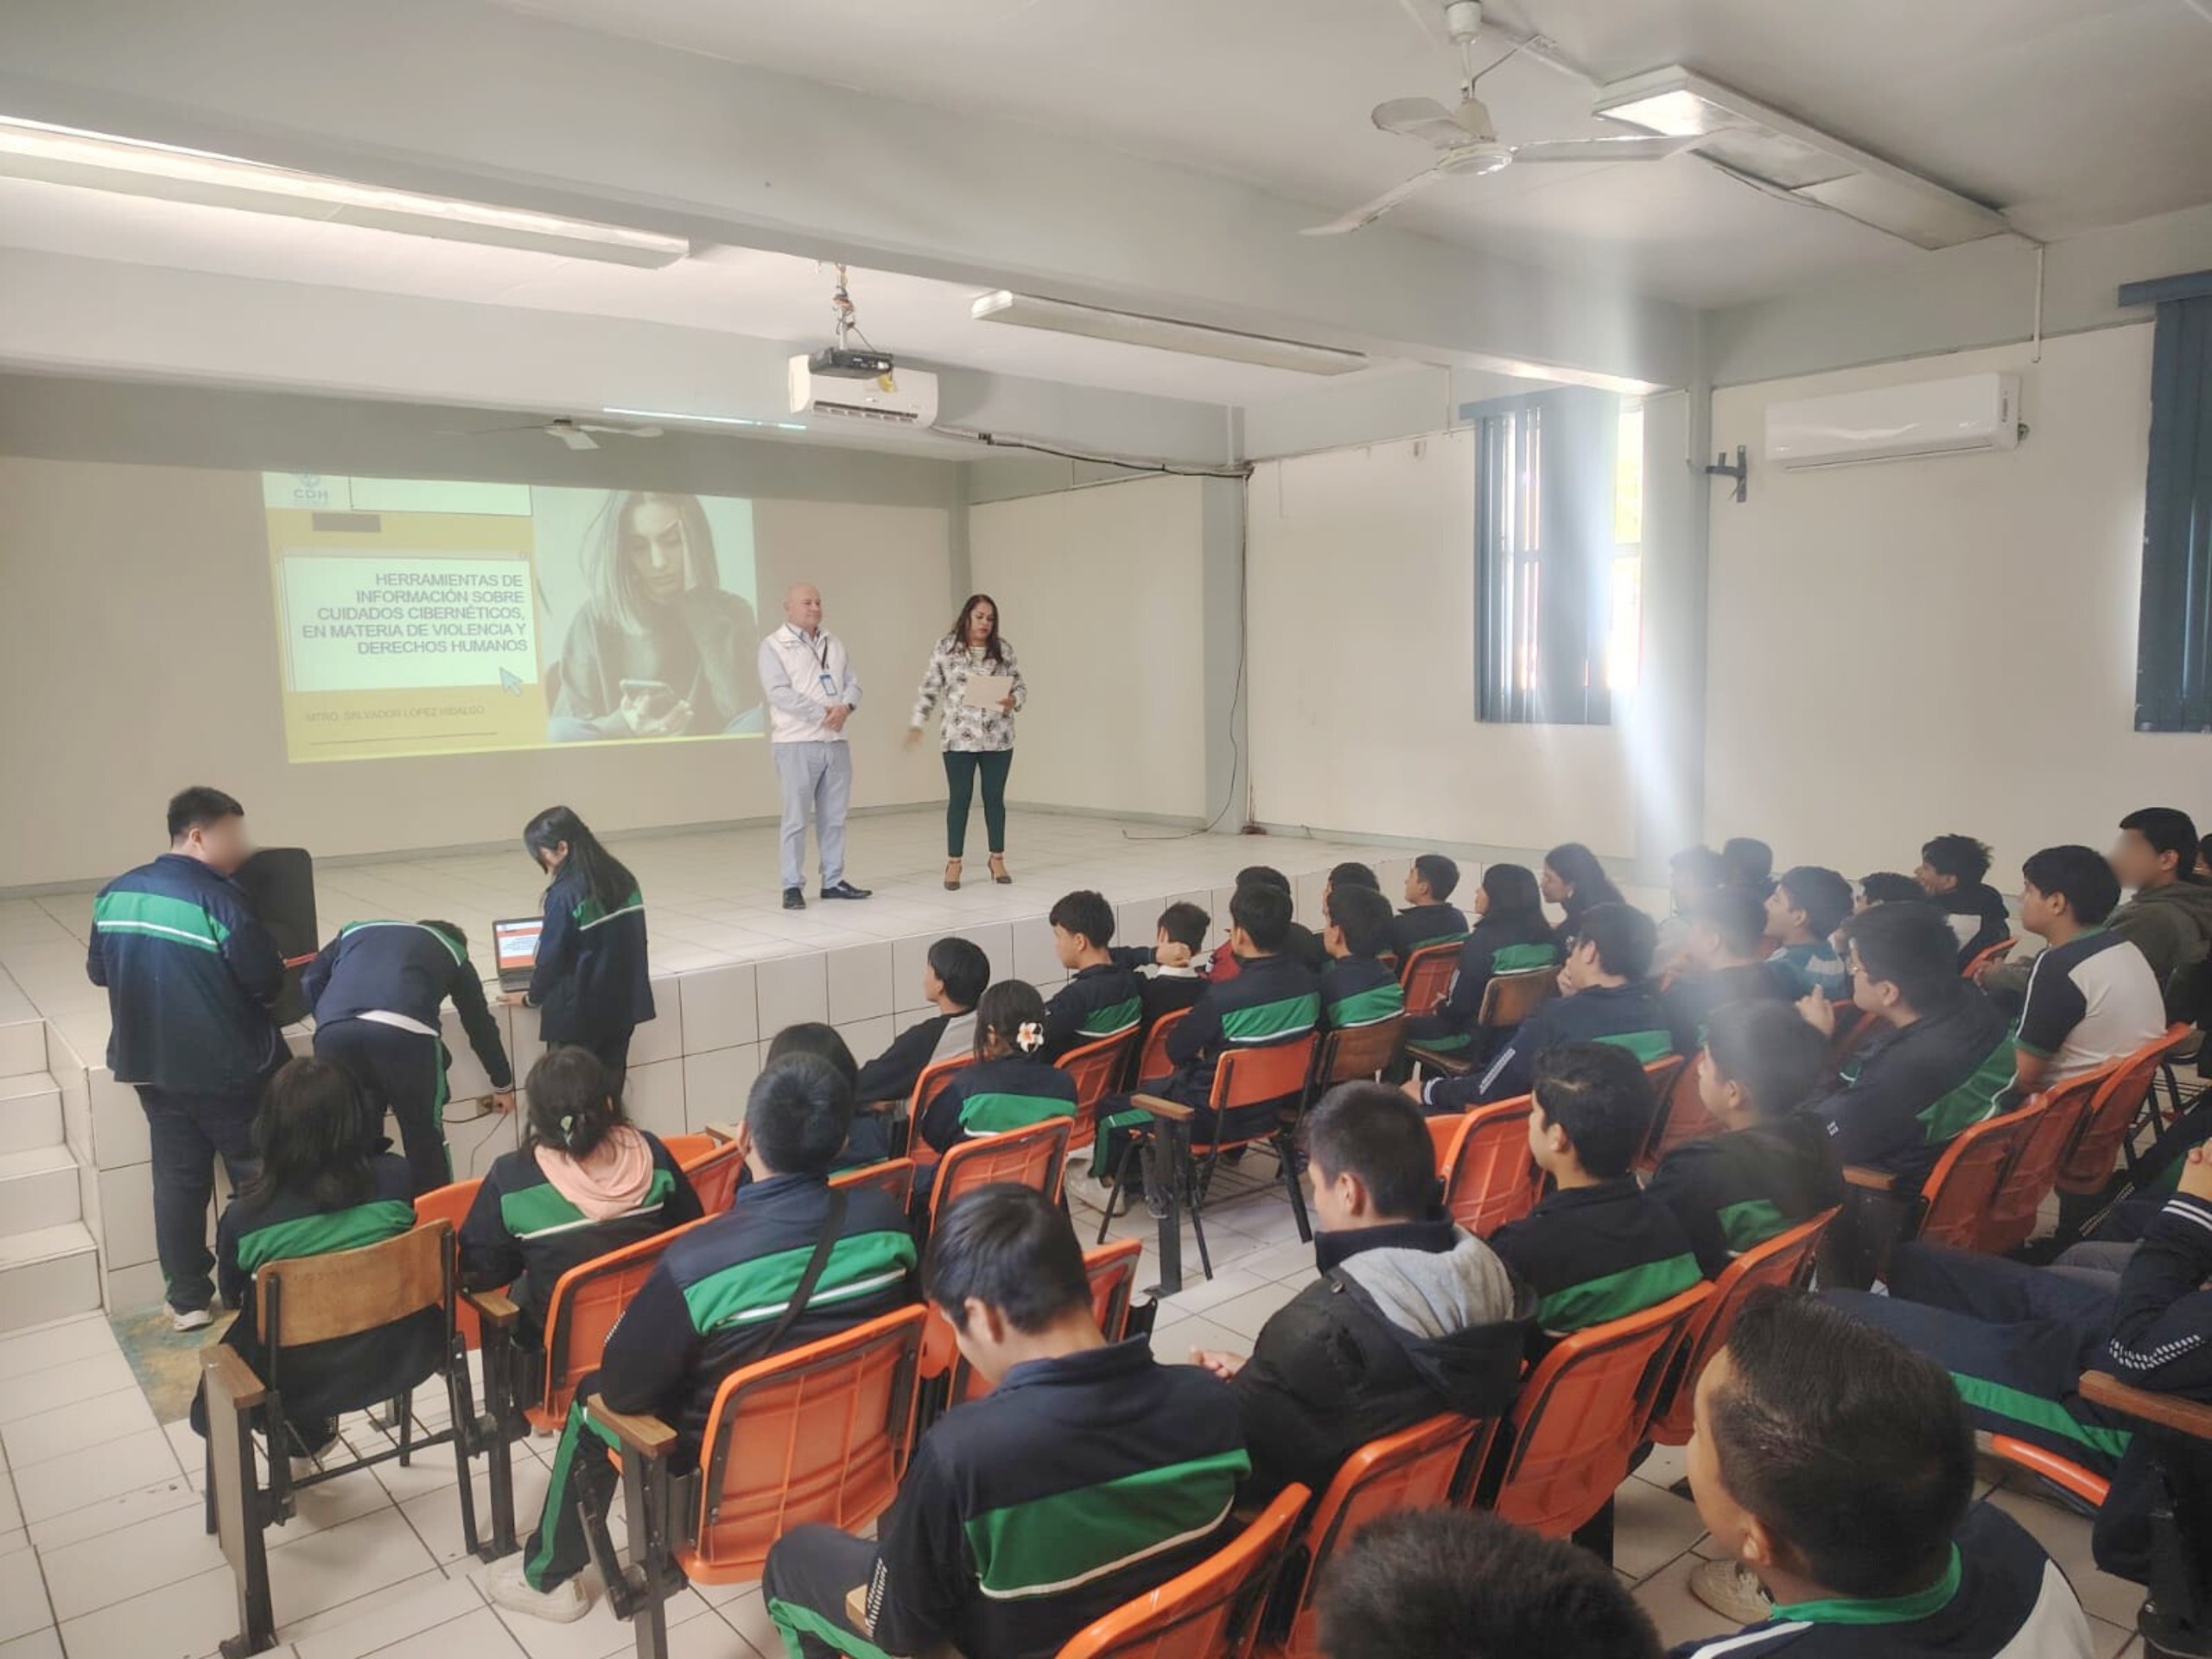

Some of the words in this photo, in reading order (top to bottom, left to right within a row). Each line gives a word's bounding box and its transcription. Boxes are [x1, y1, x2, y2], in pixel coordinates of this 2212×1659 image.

[293, 489, 328, 499] CDH
[375, 573, 499, 587] HERRAMIENTAS
[502, 575, 524, 587] DE
[356, 588, 468, 603] INFORMACIÓN
[472, 590, 524, 604] SOBRE
[317, 607, 404, 620] CUIDADOS
[408, 605, 525, 621] CIBERNÉTICOS,
[302, 625, 326, 639] EN
[330, 624, 404, 638] MATERIA
[407, 624, 429, 637] DE
[432, 623, 513, 637] VIOLENCIA
[514, 623, 527, 636] Y
[357, 640, 448, 655] DERECHOS
[451, 639, 528, 653] HUMANOS
